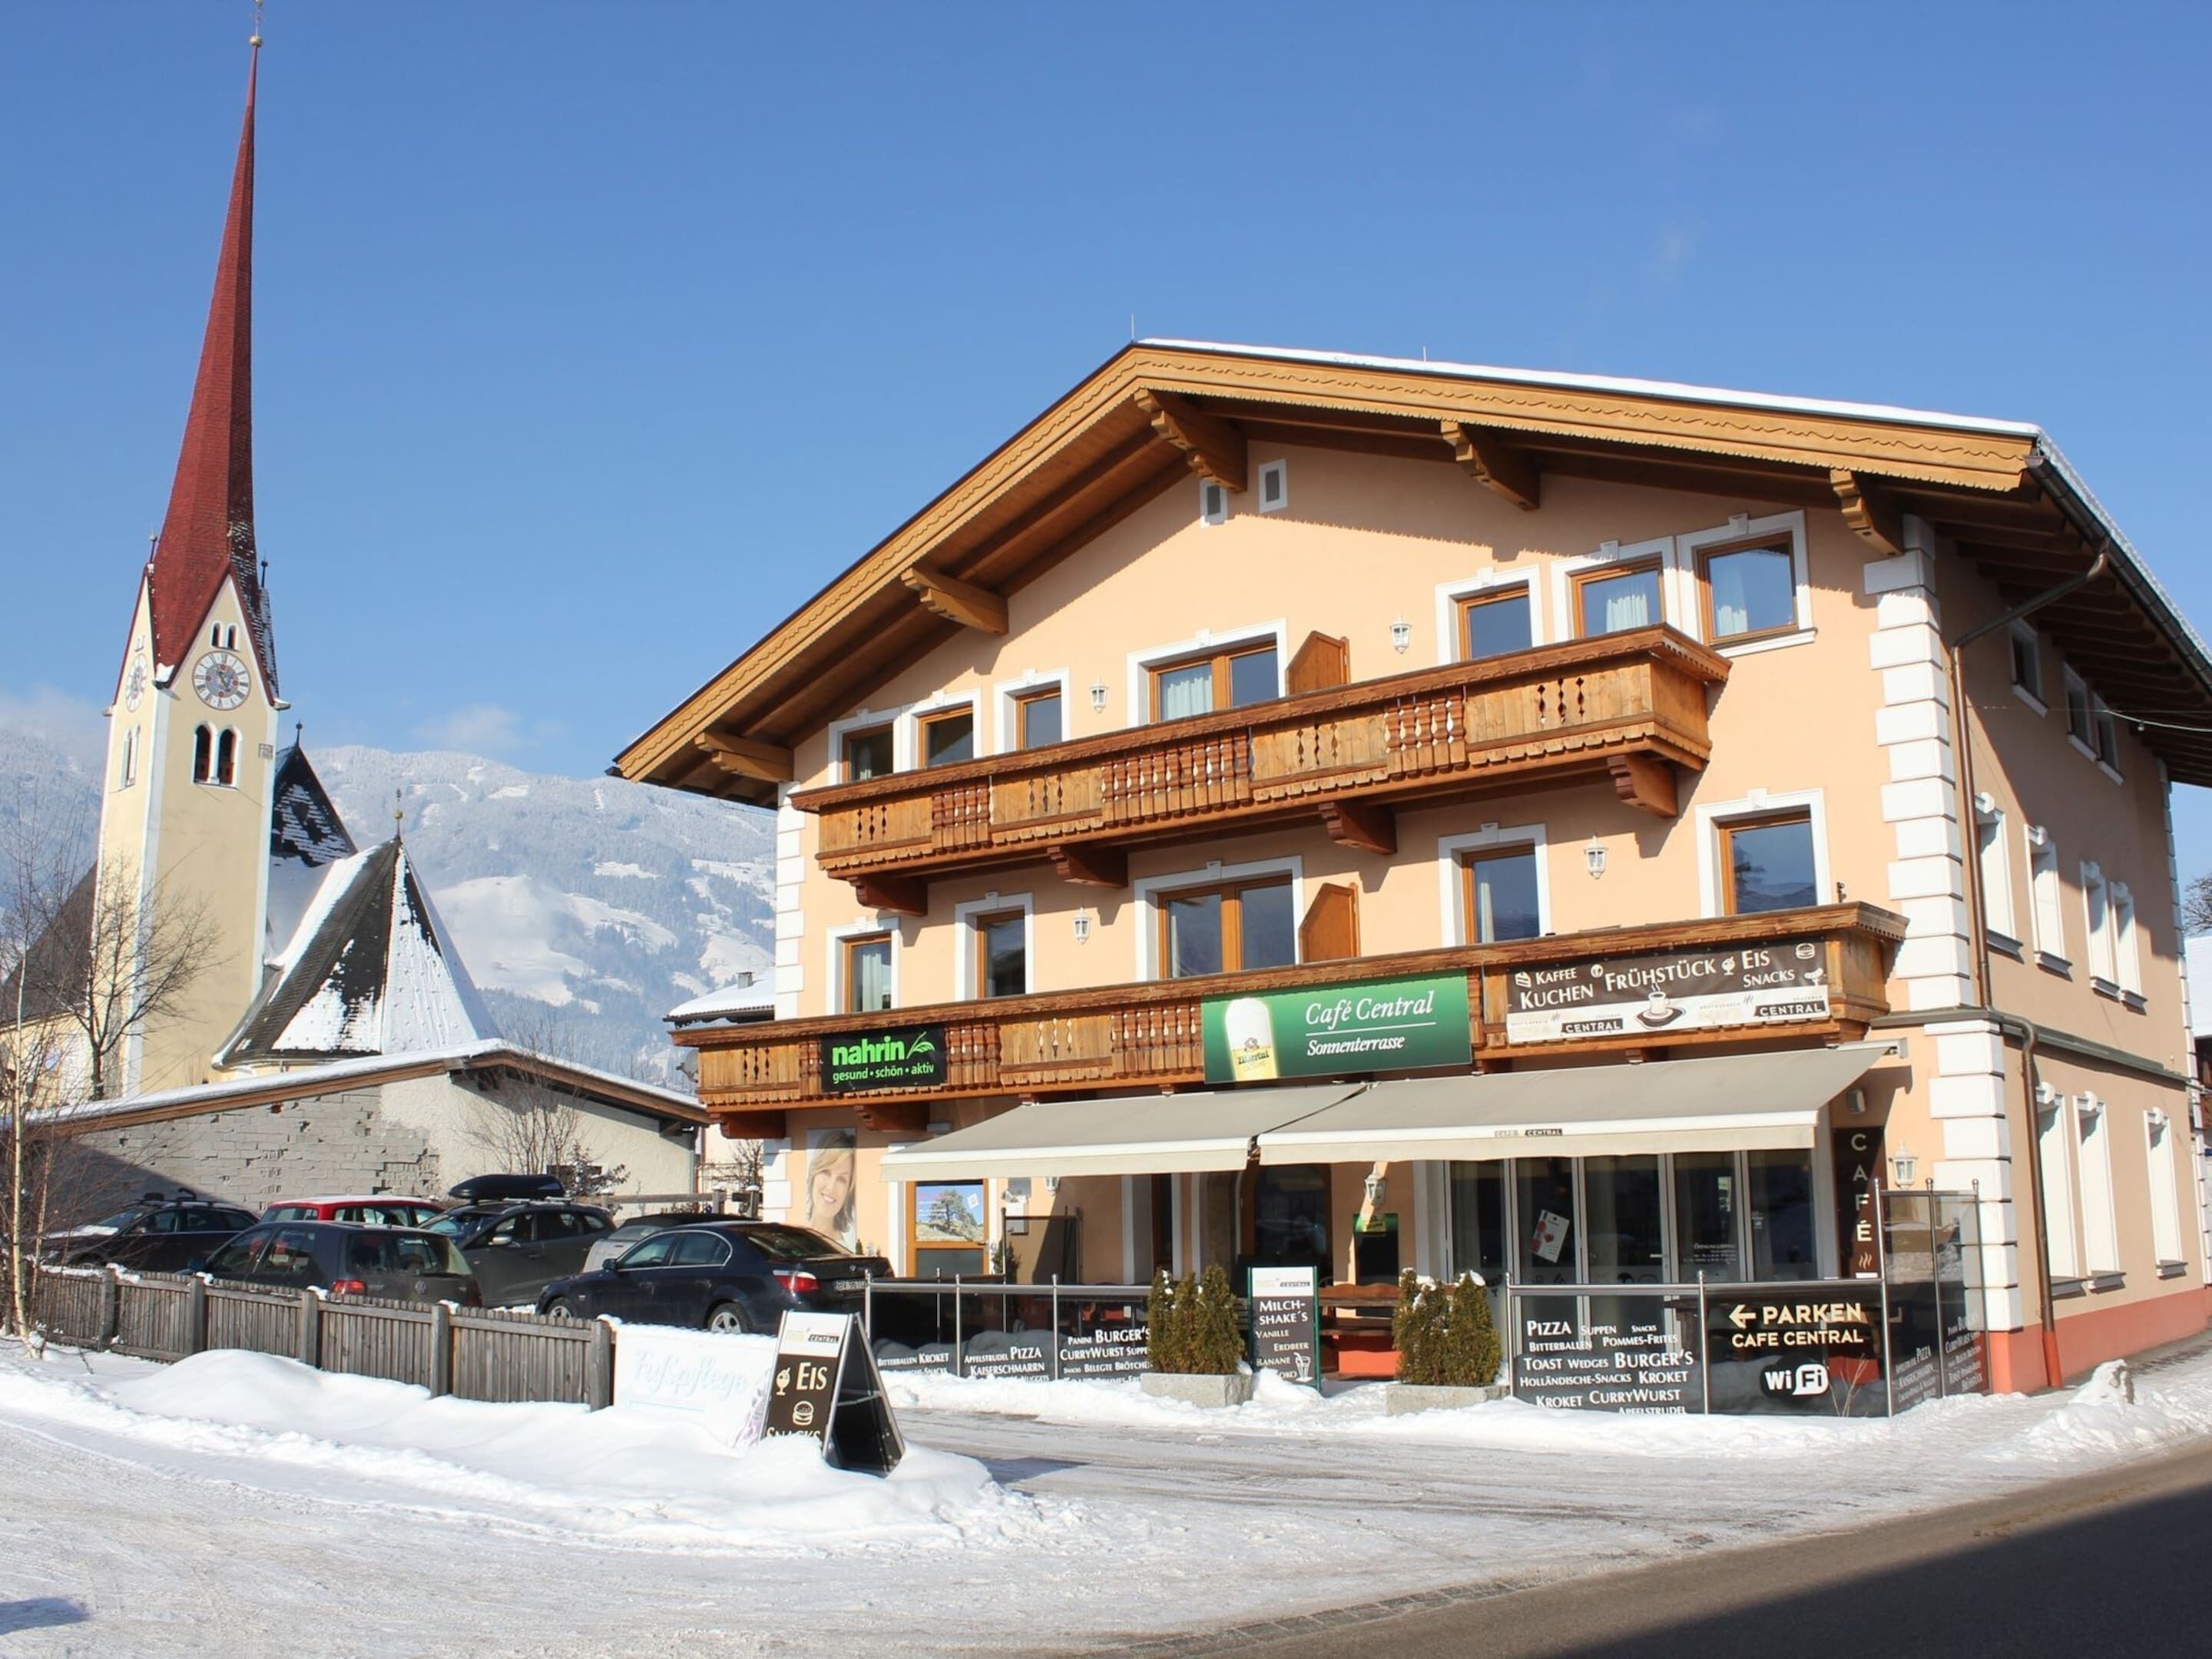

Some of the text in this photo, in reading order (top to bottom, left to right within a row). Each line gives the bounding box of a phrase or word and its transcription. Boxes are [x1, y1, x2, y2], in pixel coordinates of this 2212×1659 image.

[1741, 950, 1770, 969] EIS
[1536, 968, 1578, 985] KAFFEE
[1605, 958, 1717, 992] FRÜHSTÜCK
[1743, 969, 1795, 988] SNACKS
[1520, 984, 1594, 1009] KUCHEN
[1306, 990, 1435, 1030] Café Central
[1760, 1003, 1822, 1016] CENTRAL
[1566, 1021, 1620, 1033] CENTRAL
[832, 1035, 905, 1066] nahrin
[1307, 1037, 1405, 1056] Sonnenterrasse
[833, 1061, 934, 1084] gesund schön aktiv
[1527, 1128, 1562, 1137] CENTRAL
[1850, 1133, 1873, 1242] CAFÉ
[1260, 1300, 1306, 1312] MILCH-
[1763, 1303, 1862, 1325] PARKEN
[1256, 1330, 1290, 1339] VANILLE
[1527, 1320, 1657, 1336] PIZZA SUPPEN SNACKS
[810, 1335, 839, 1343] CENTRAL
[1068, 1336, 1092, 1345] PANINI
[1529, 1333, 1679, 1352] BITTERBALLEN POMMES-FRITES
[1732, 1329, 1864, 1348] CAFE CENTRAL
[964, 1346, 1041, 1363] APFELSTRUDEL PIZZA
[1060, 1346, 1149, 1360] CURRYWURST SUPPE
[1273, 1343, 1309, 1352] ERDBEER
[877, 1353, 949, 1366] BITTERBALLEN KROKET
[1524, 1357, 1609, 1370] TOAST WEDGES
[796, 1362, 828, 1390] EIS
[971, 1362, 1045, 1376] KAISERSCHMARRN
[1084, 1363, 1113, 1373] BELEGTE
[1278, 1370, 1297, 1379] OKO
[1520, 1371, 1688, 1387] HOLLÄNDISCHE-SNACKS KROKET
[1536, 1388, 1681, 1408] KROKET CURRYWURST
